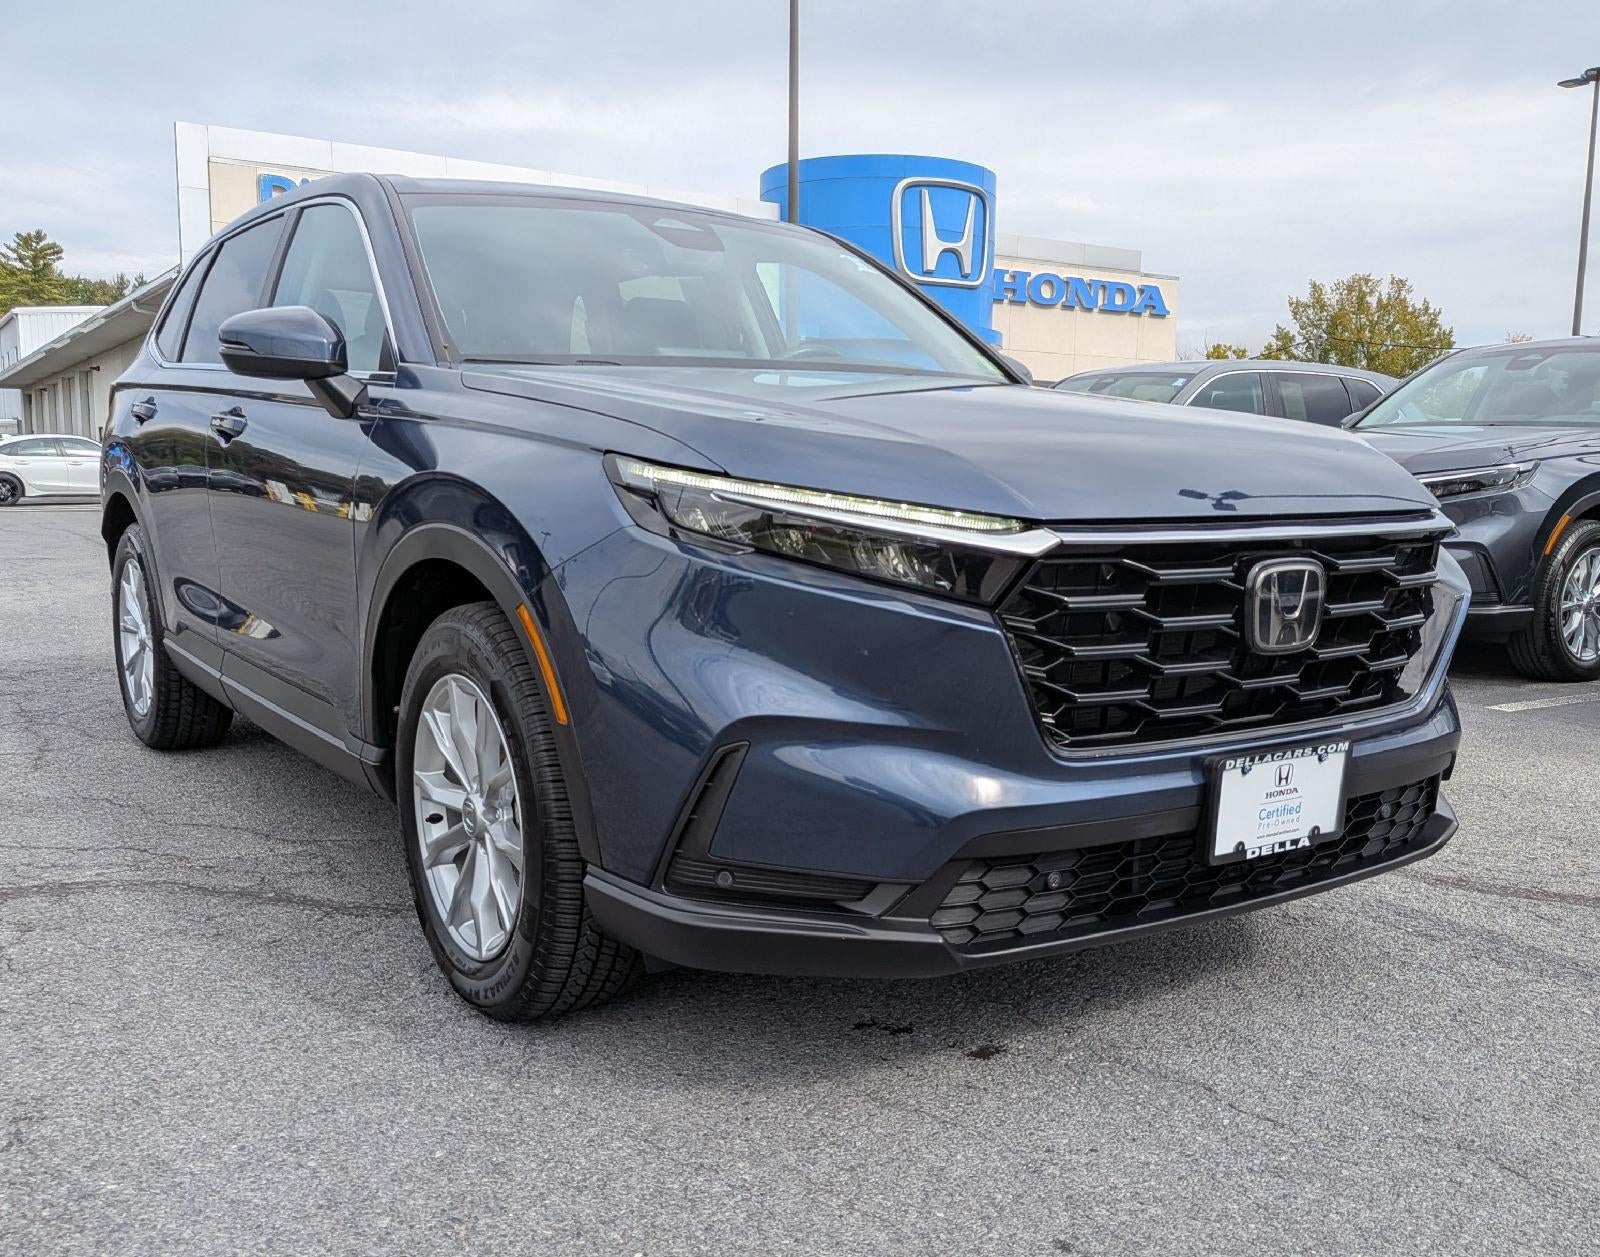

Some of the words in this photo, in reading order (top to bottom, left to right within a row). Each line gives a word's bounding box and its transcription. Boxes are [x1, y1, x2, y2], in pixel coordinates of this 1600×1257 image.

[993, 268, 1170, 317] HONDA
[1225, 741, 1350, 770] DELLACARS.COM
[1264, 787, 1299, 800] HONDA
[1258, 801, 1302, 821] Certified
[1258, 816, 1301, 830] Pre-Owned
[1246, 836, 1311, 860] DELLA
